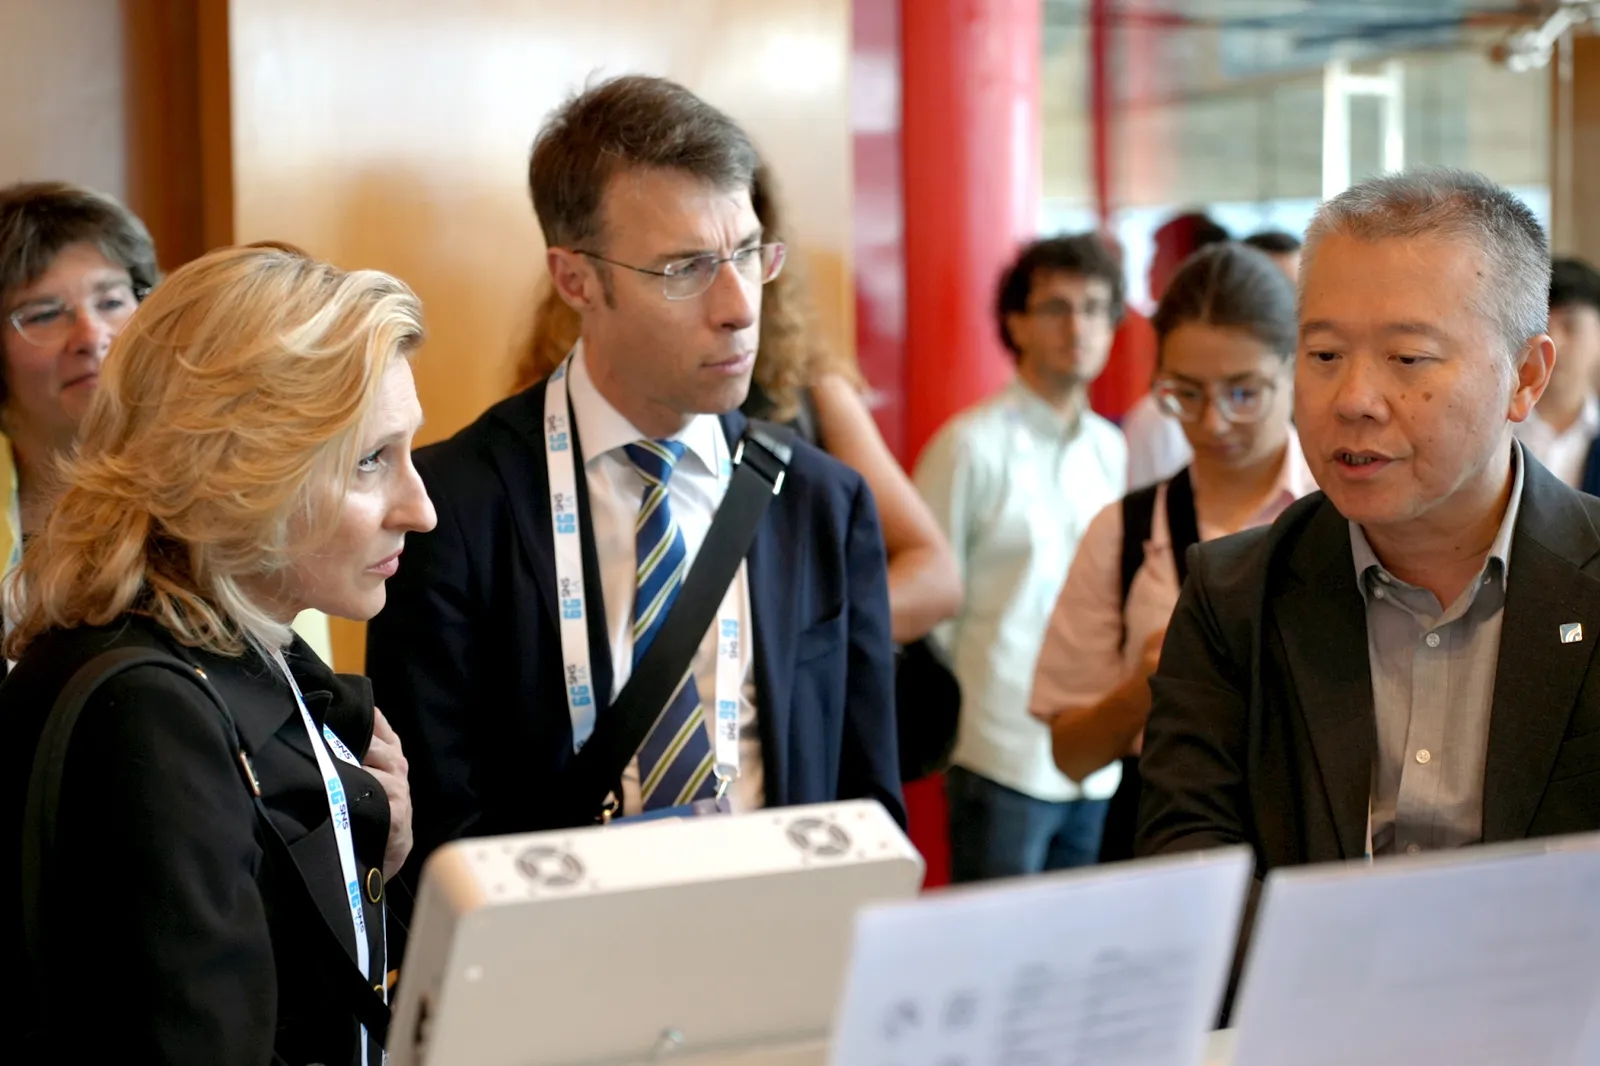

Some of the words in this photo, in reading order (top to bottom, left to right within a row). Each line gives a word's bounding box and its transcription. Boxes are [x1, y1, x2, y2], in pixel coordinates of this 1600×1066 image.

[556, 513, 575, 534] 6G
[562, 598, 582, 619] 6G
[570, 685, 591, 707] 6G
[719, 700, 736, 719] 6G
[334, 740, 352, 760] SNS
[327, 777, 345, 805] 6G
[340, 804, 349, 830] SNS
[349, 880, 360, 908] 6G
